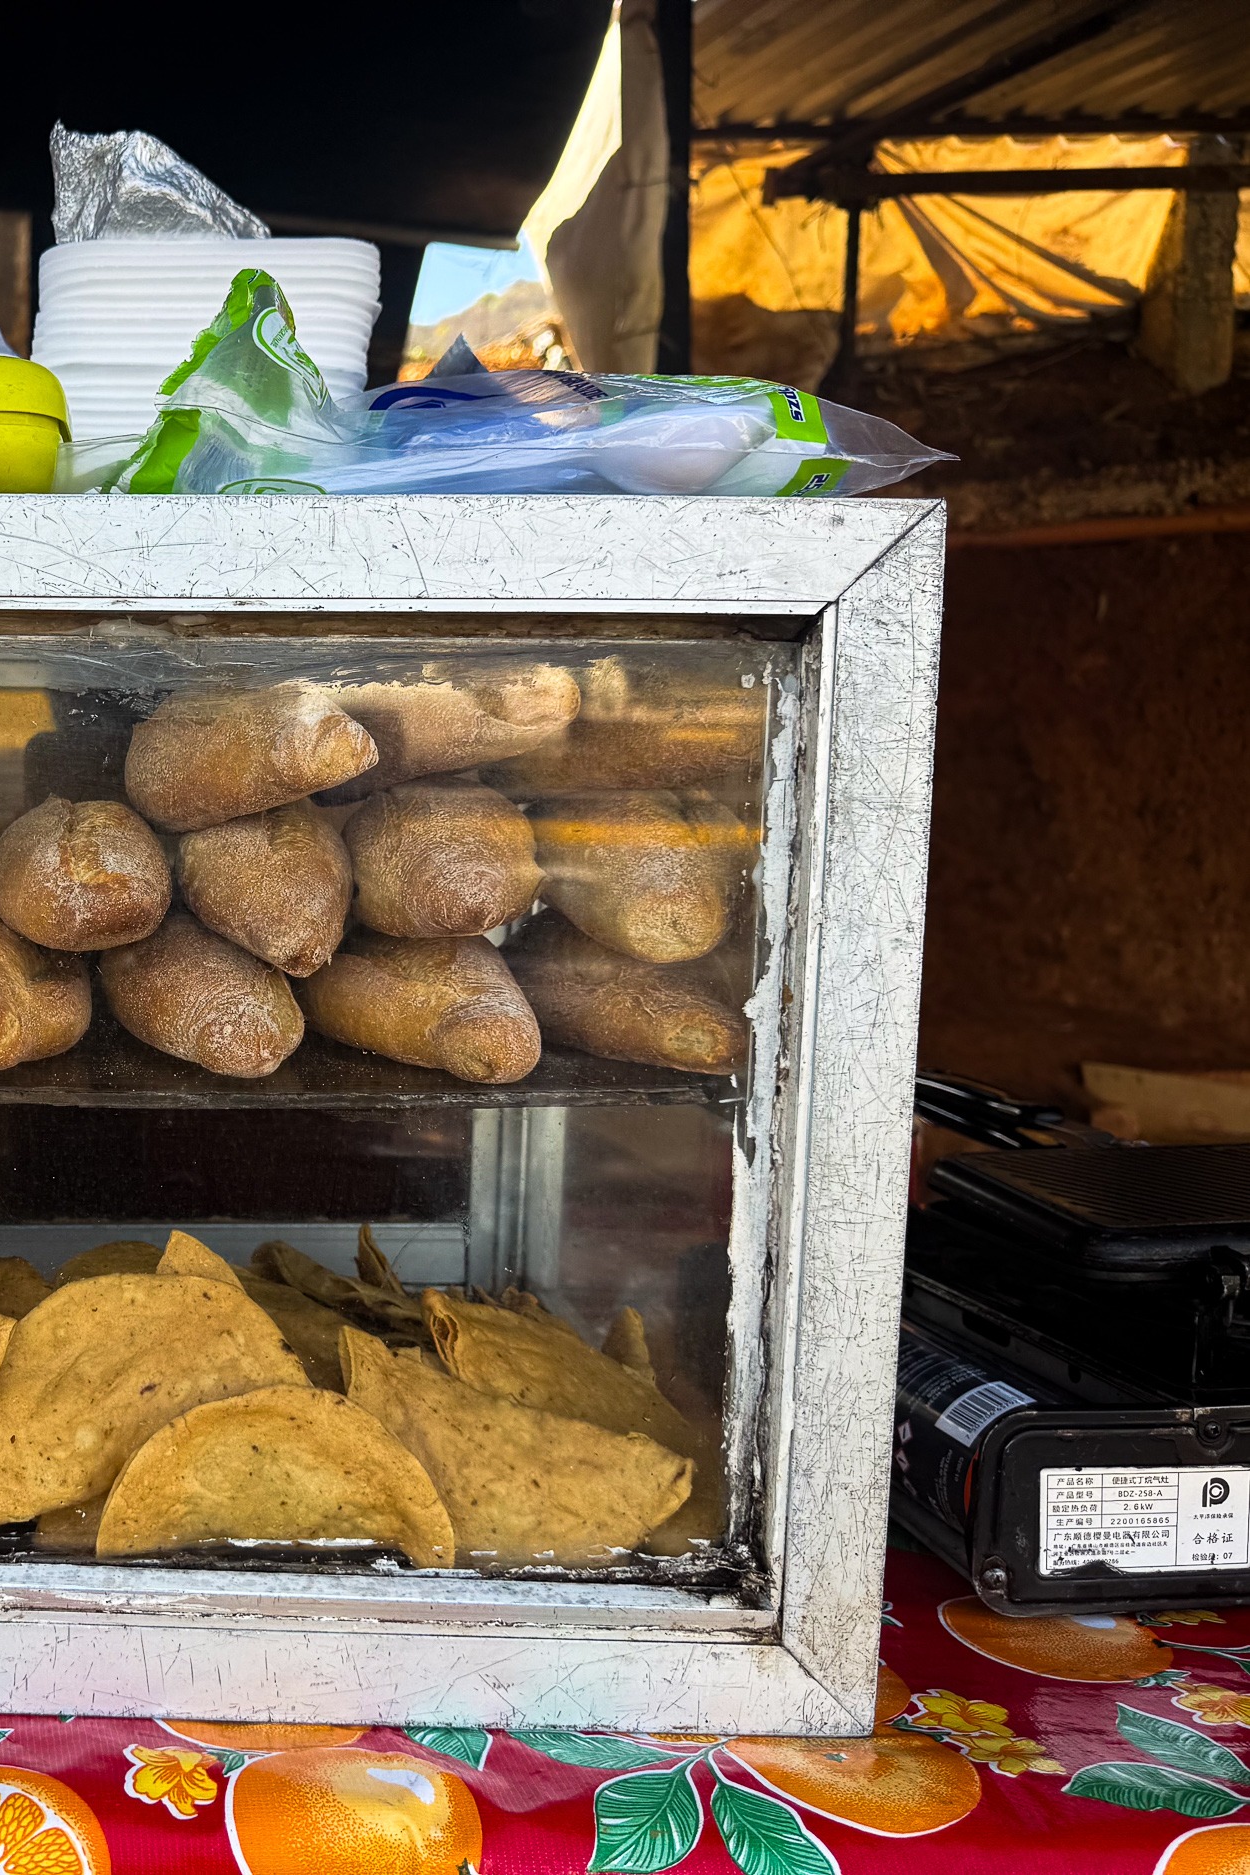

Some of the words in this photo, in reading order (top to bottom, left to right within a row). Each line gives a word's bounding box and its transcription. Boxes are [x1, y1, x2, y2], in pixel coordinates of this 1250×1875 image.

[1056, 1477, 1094, 1486] 产品名称
[1056, 1491, 1094, 1499] 产品型号
[1117, 1489, 1163, 1498] BDZ-258-A
[1052, 1503, 1098, 1513] 额定热负荷
[1056, 1517, 1094, 1527] 生产编号
[1110, 1516, 1170, 1526] 2200165865
[1192, 1532, 1234, 1545] 合格证
